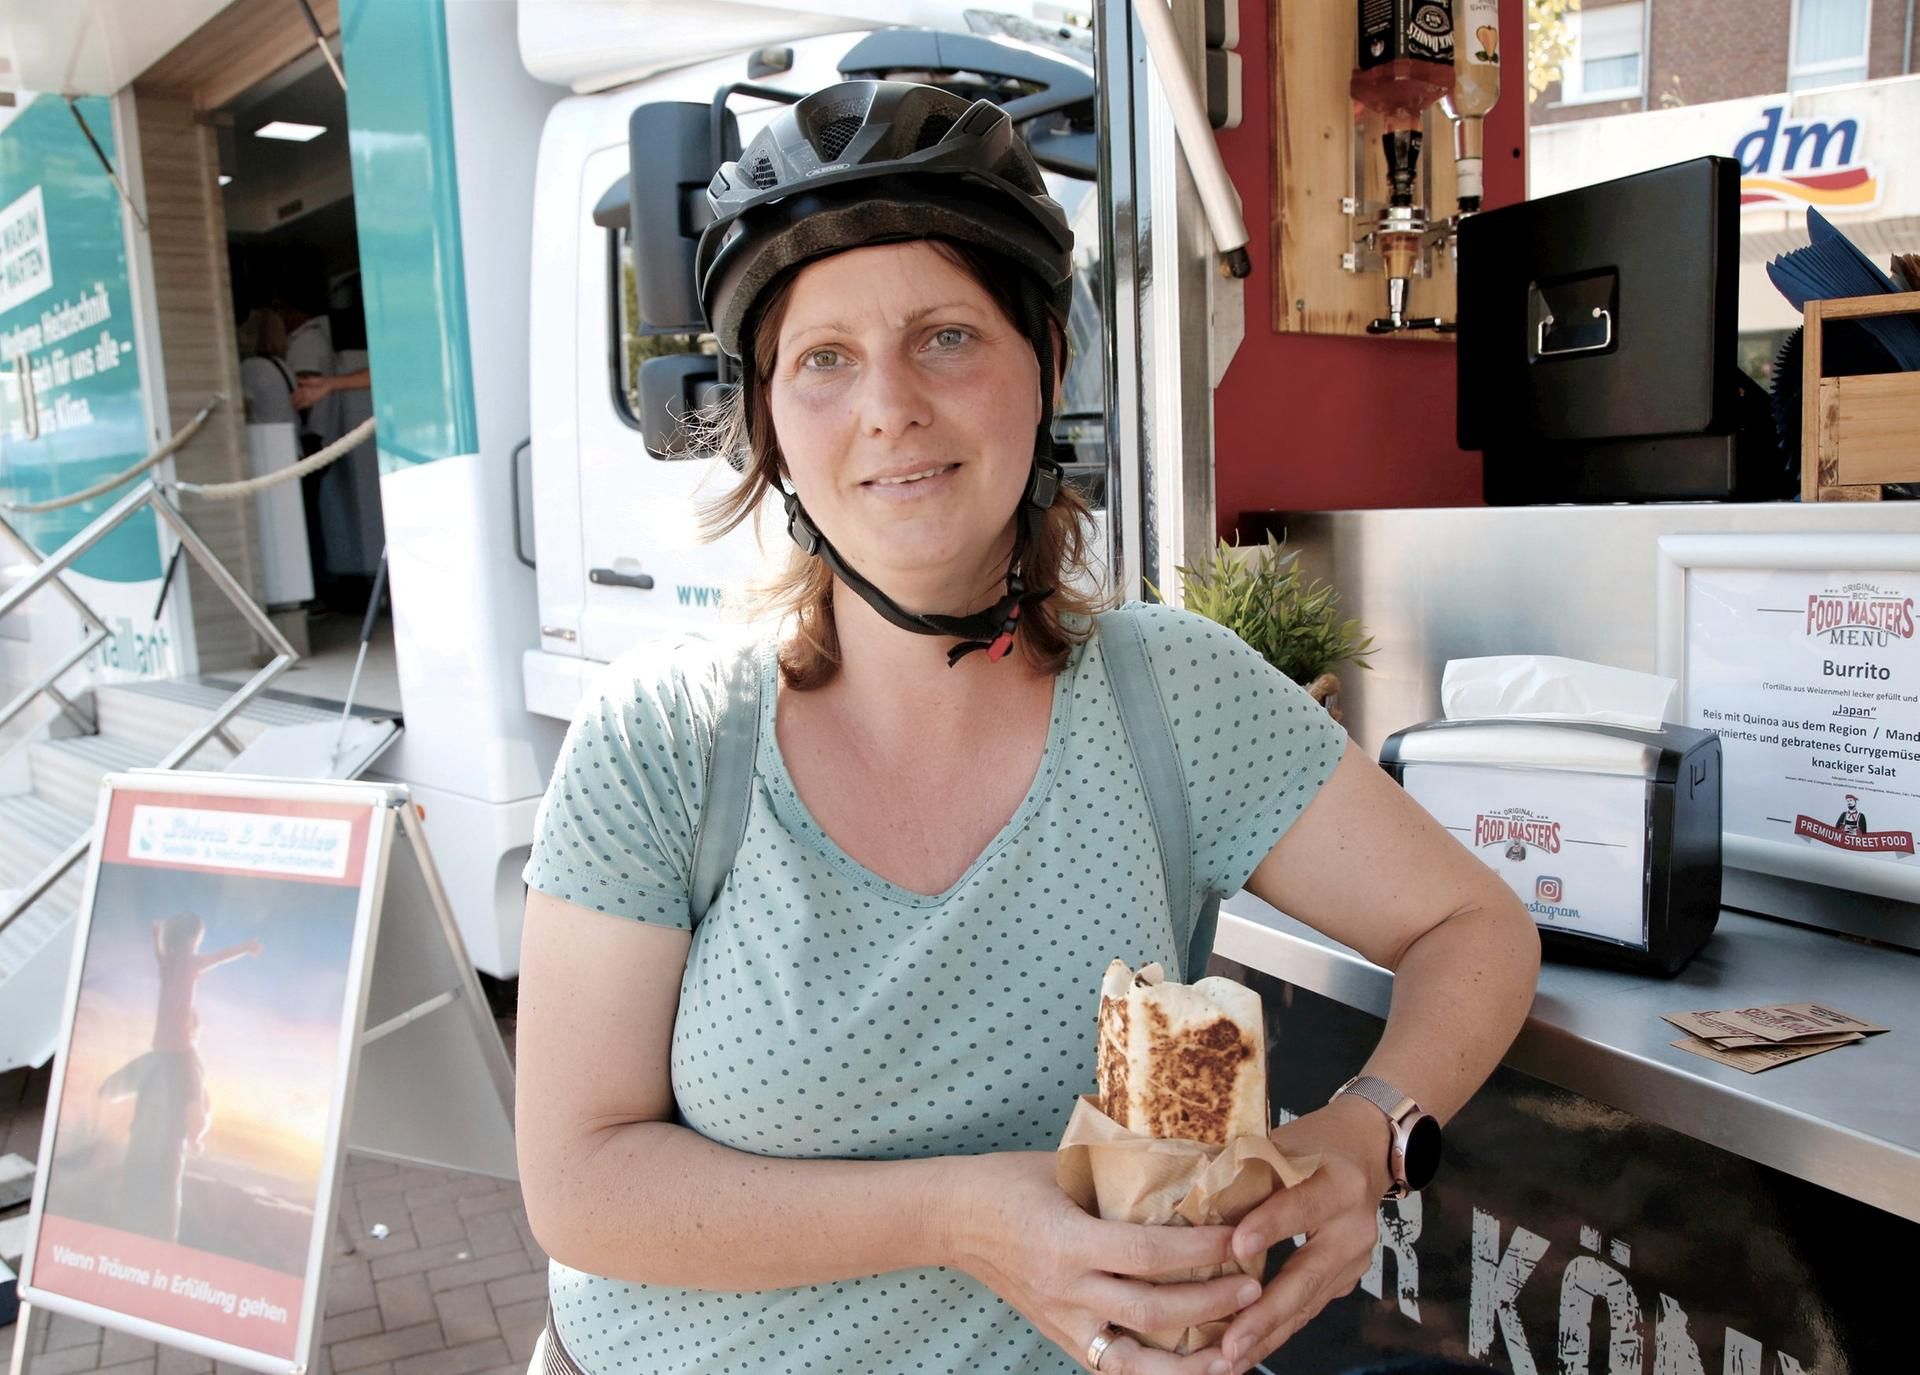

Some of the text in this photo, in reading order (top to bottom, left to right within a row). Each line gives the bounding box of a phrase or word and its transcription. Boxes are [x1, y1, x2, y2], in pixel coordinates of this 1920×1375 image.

[1733, 107, 1857, 175] dm
[1842, 583, 1880, 595] ORIGINAL
[1852, 592, 1868, 600] BCC
[1806, 594, 1914, 639] FOOD MASTERS
[1830, 629, 1889, 648] MENÜ
[1823, 659, 1891, 681] Burrito
[1762, 682, 1918, 703] (Tortillas aus Weizenmehl lecker gefüllt und
[1703, 709, 1722, 720] Reis
[1724, 712, 1740, 723] mit
[1743, 713, 1779, 727] Quinoa
[1781, 719, 1800, 729] aus
[1802, 720, 1827, 732] dem
[1829, 723, 1867, 737] Region
[1759, 733, 1779, 744] und
[1781, 736, 1841, 752] gebratenes
[1844, 743, 1920, 762] Currygemüse
[1811, 756, 1896, 778] knackiger Salat
[1503, 807, 1534, 818] ORIGINAL
[1475, 814, 1561, 854] FOOD MASTERS
[1800, 820, 1907, 848] PREMIUM STREET FOOD
[52, 1244, 288, 1324] Wenn Träume in Erfüllung gehen
